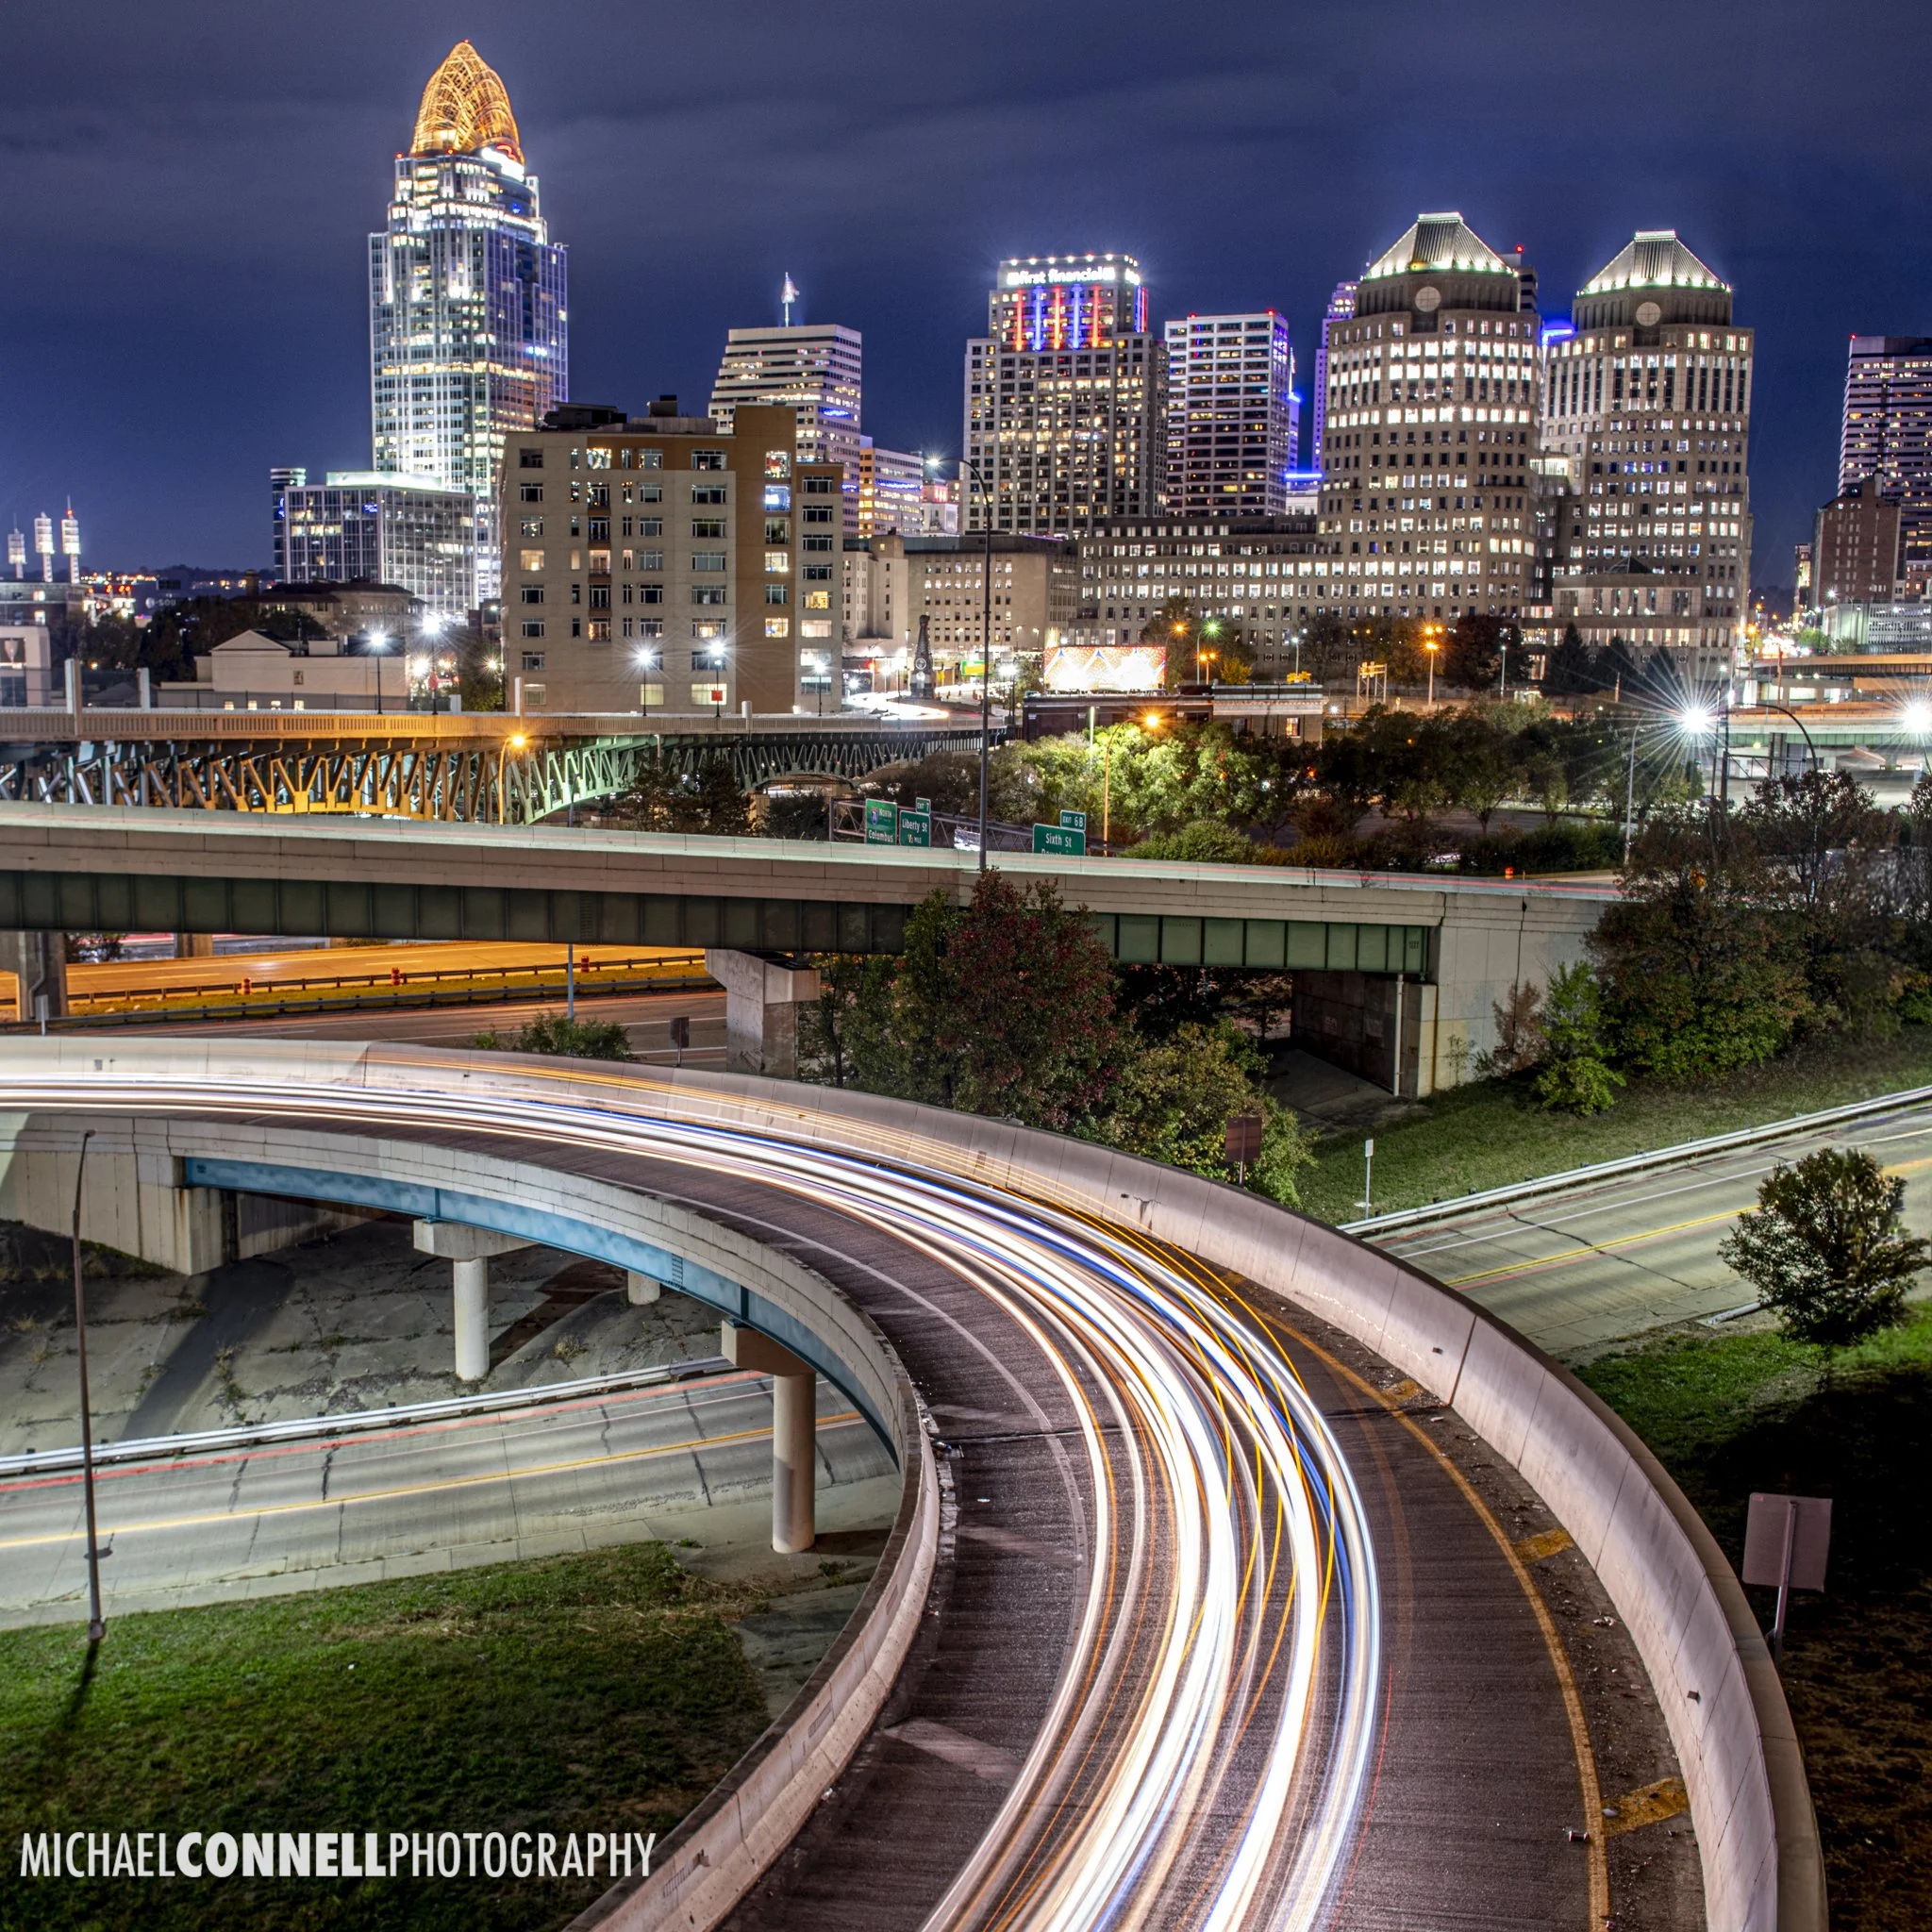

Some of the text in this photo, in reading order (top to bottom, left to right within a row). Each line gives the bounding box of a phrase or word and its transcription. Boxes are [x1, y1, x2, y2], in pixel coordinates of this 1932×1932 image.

[1048, 266, 1102, 283] financial
[902, 818, 927, 833] Liberty St
[868, 829, 893, 843] Columbus
[1045, 833, 1072, 848] Sixth St
